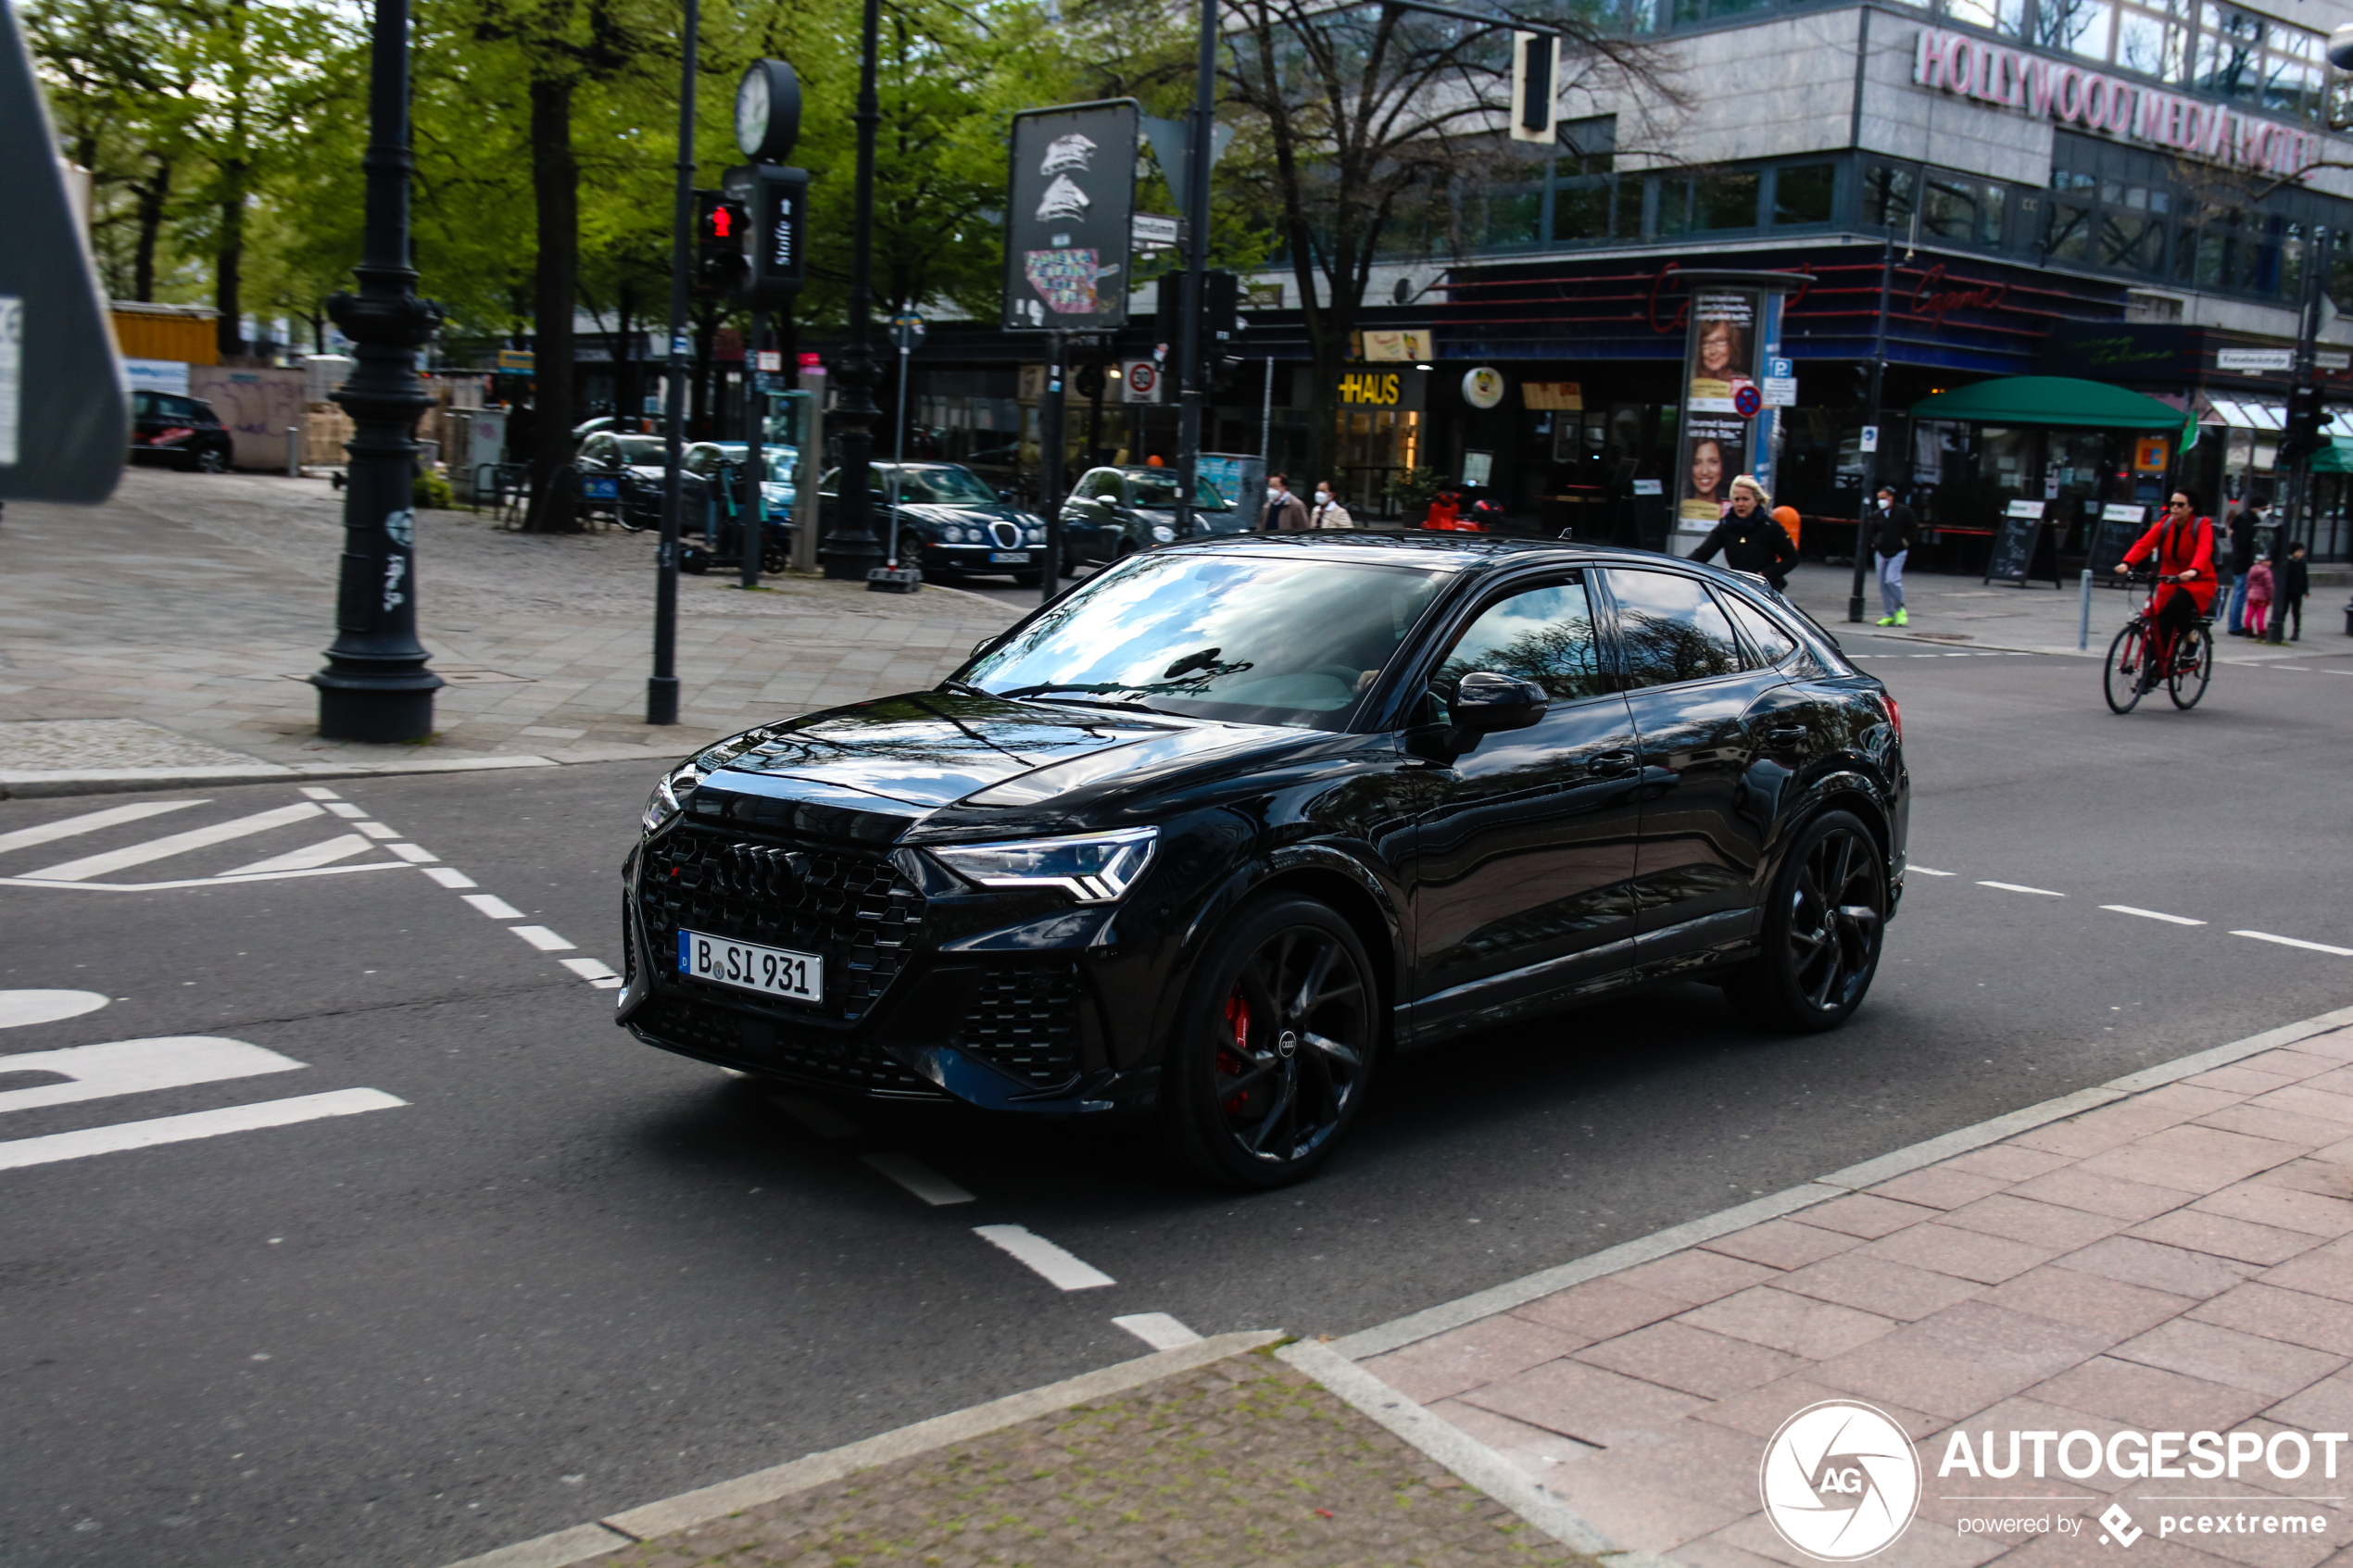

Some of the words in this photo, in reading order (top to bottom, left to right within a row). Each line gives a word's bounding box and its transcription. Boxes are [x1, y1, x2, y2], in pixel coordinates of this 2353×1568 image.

[1917, 29, 2131, 133] HOLLYWOOD
[2137, 91, 2230, 163] MEDIA
[2236, 115, 2315, 180] HOTEL
[774, 220, 791, 266] Stoffe
[698, 939, 712, 972] B
[726, 946, 755, 985] SI
[762, 954, 809, 995] 931
